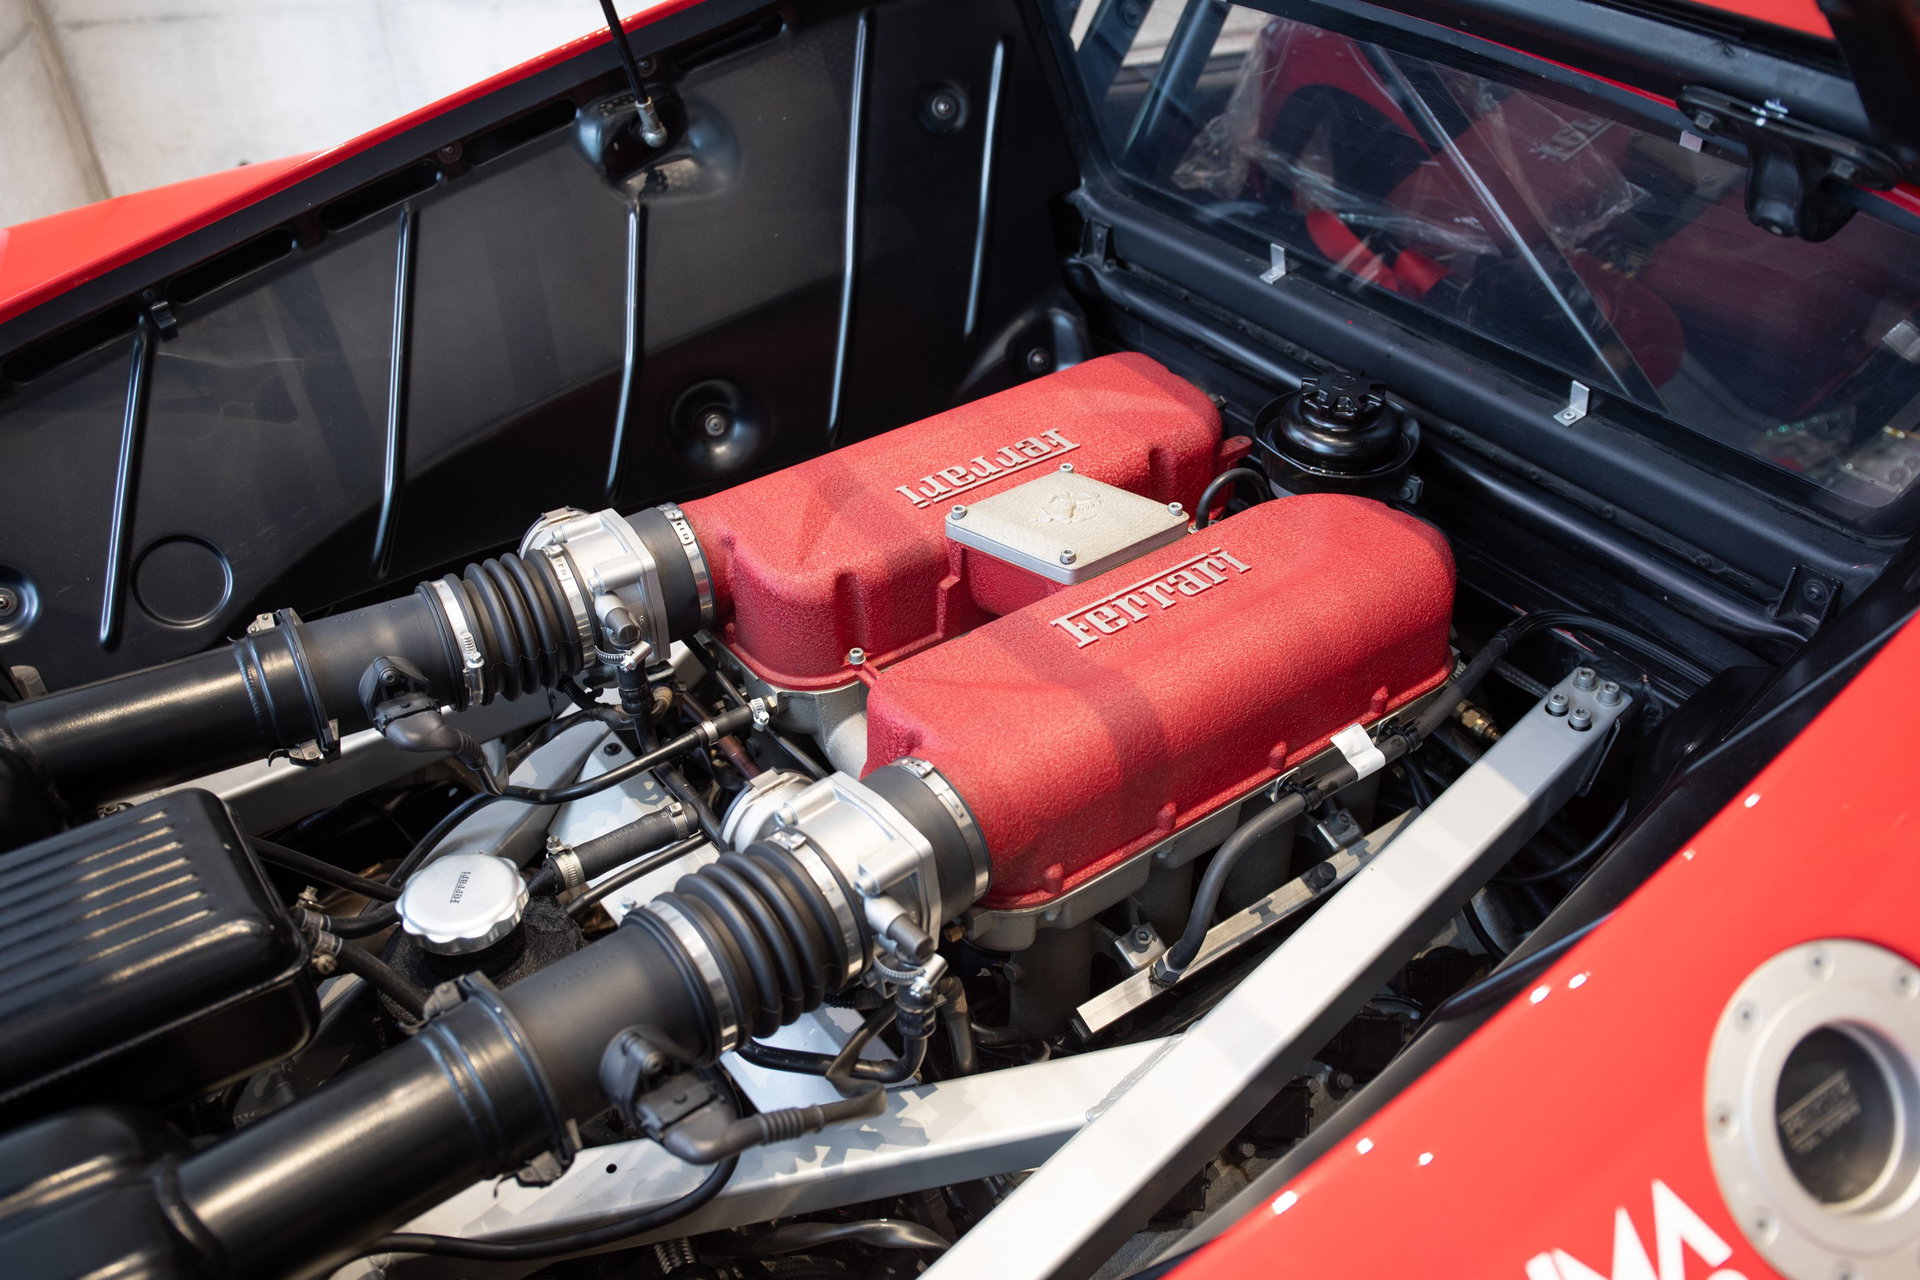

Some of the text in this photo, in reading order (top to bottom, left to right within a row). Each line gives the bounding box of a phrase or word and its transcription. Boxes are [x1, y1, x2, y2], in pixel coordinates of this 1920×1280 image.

[895, 428, 1081, 508] Ferrari
[1050, 547, 1252, 648] Ferrari
[450, 871, 471, 903] Ferrari
